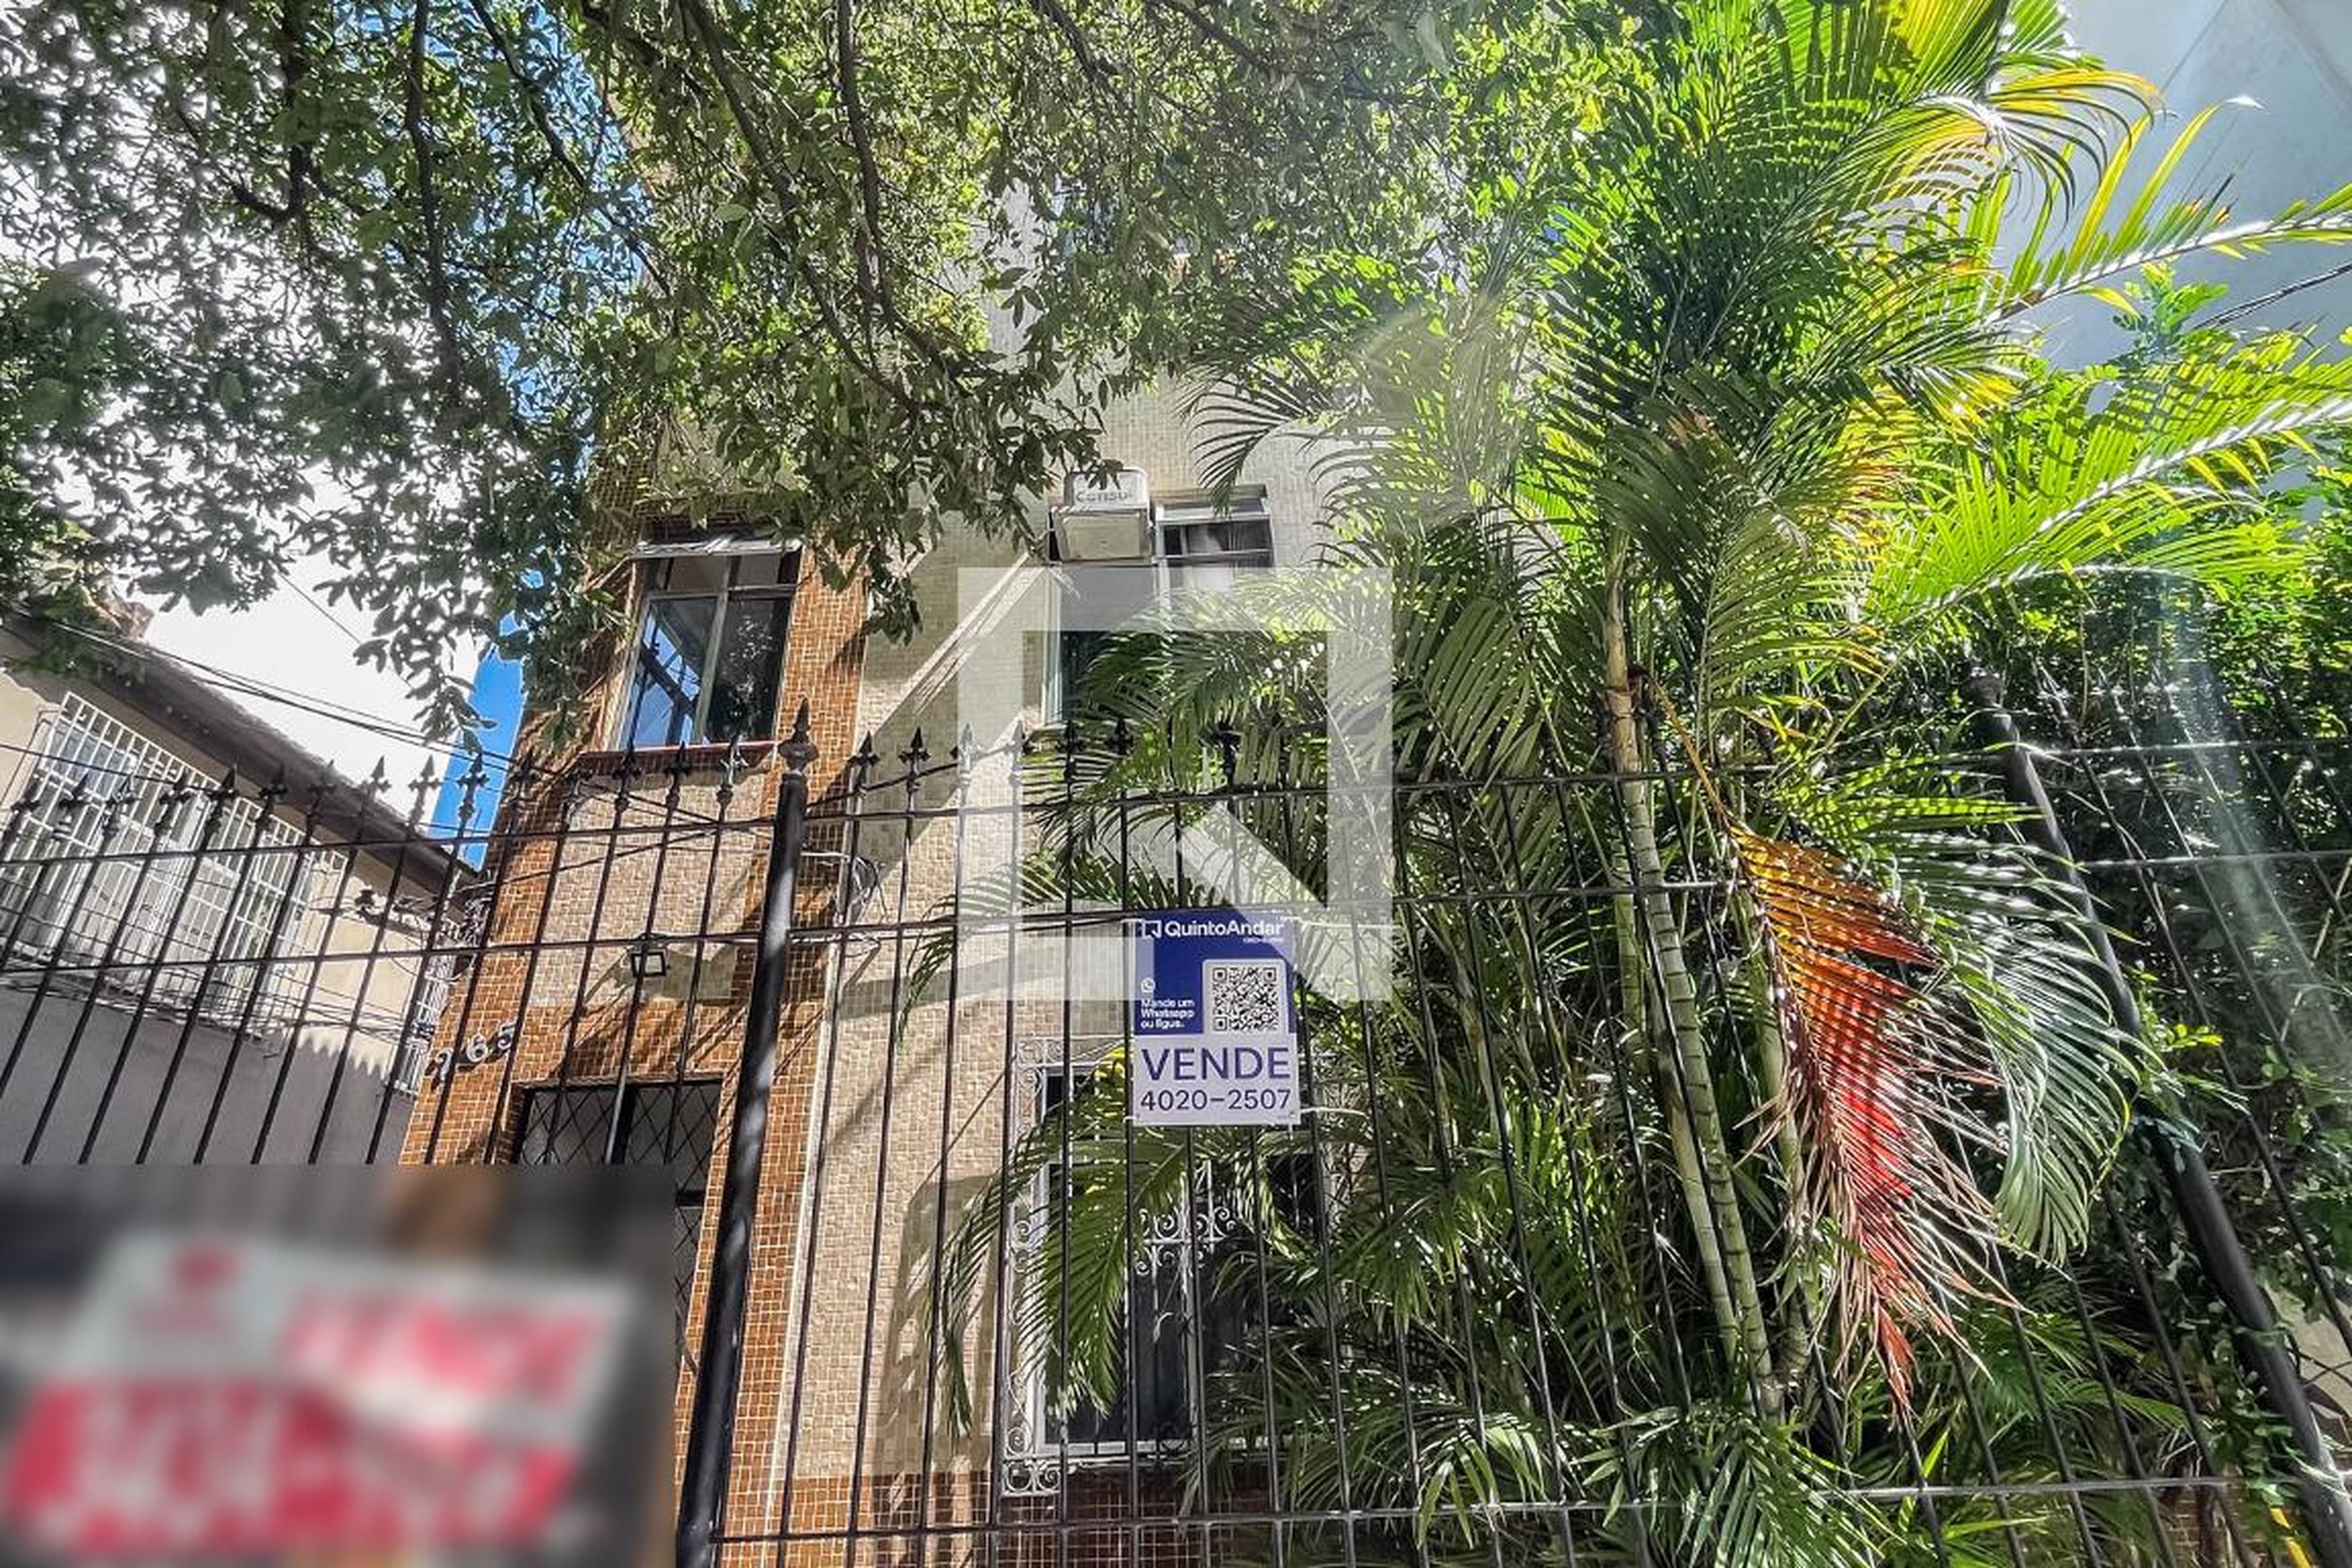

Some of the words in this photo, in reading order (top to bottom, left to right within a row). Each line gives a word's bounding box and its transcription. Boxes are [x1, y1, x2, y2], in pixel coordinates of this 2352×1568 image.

[1165, 920, 1284, 937] QuintoAndar
[1140, 1020, 1154, 1028] ou
[1141, 1047, 1291, 1080] VENDE
[1140, 1089, 1291, 1111] 4020-2507
